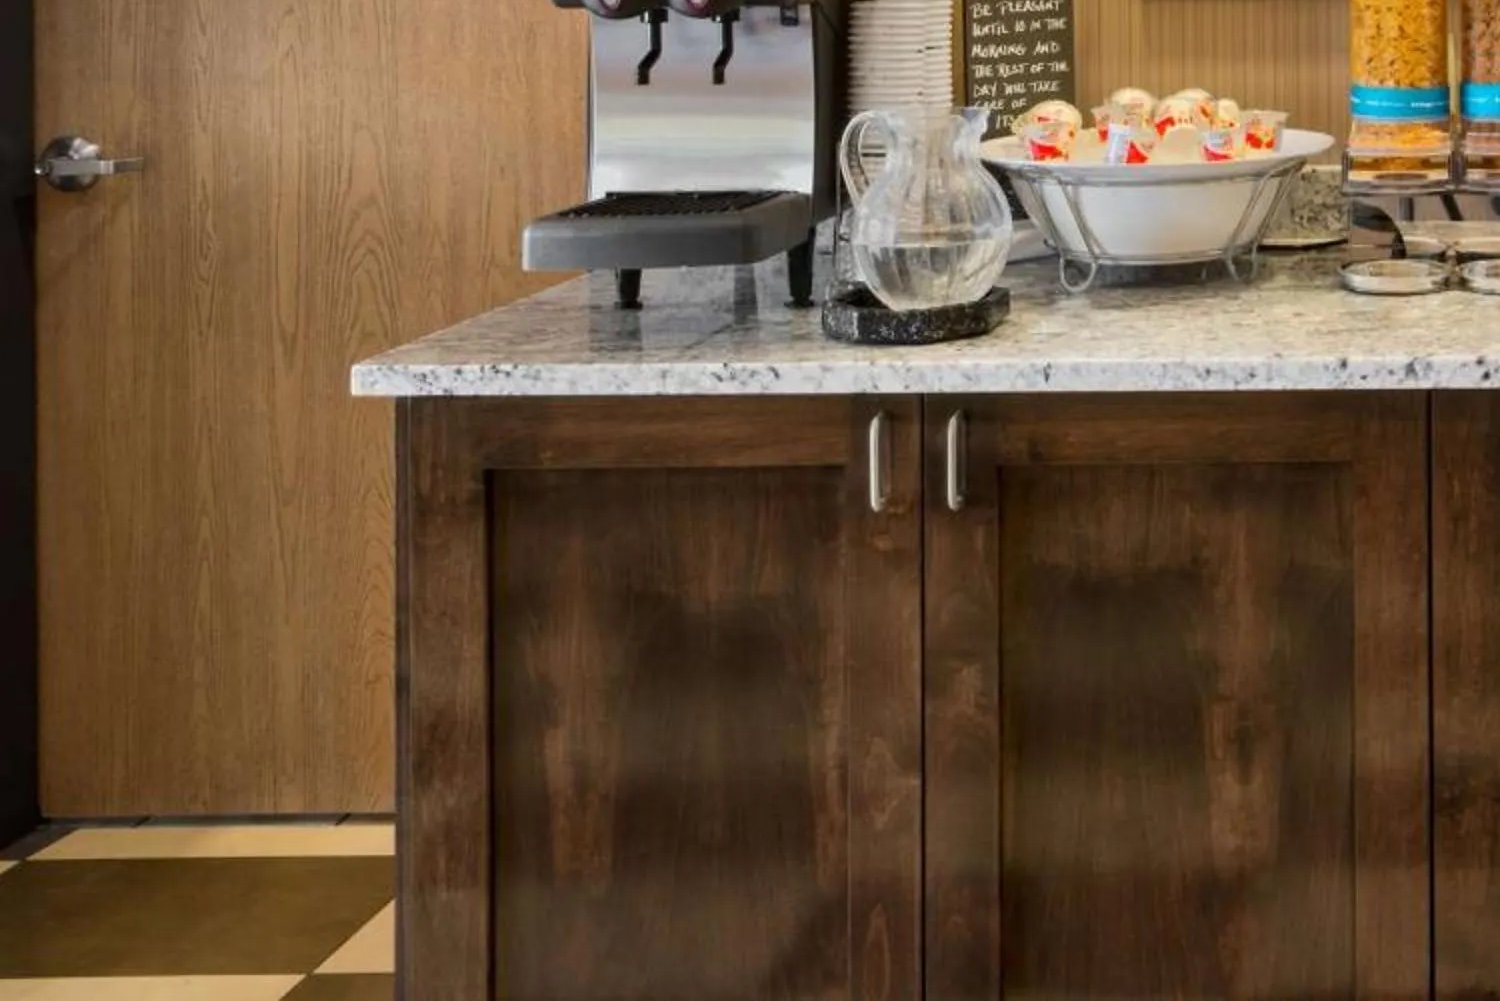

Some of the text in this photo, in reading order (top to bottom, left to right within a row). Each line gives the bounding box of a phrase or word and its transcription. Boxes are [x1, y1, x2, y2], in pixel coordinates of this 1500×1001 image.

[969, 2, 992, 18] BE
[972, 21, 1009, 37] UNTIL
[1043, 17, 1067, 30] THE
[971, 40, 1060, 58] MORNING AND
[972, 63, 993, 78] THE
[996, 62, 1030, 78] REST
[1030, 62, 1045, 73] OF
[974, 81, 997, 98] DAY
[1028, 80, 1061, 93] TAKE
[1011, 97, 1027, 109] OF
